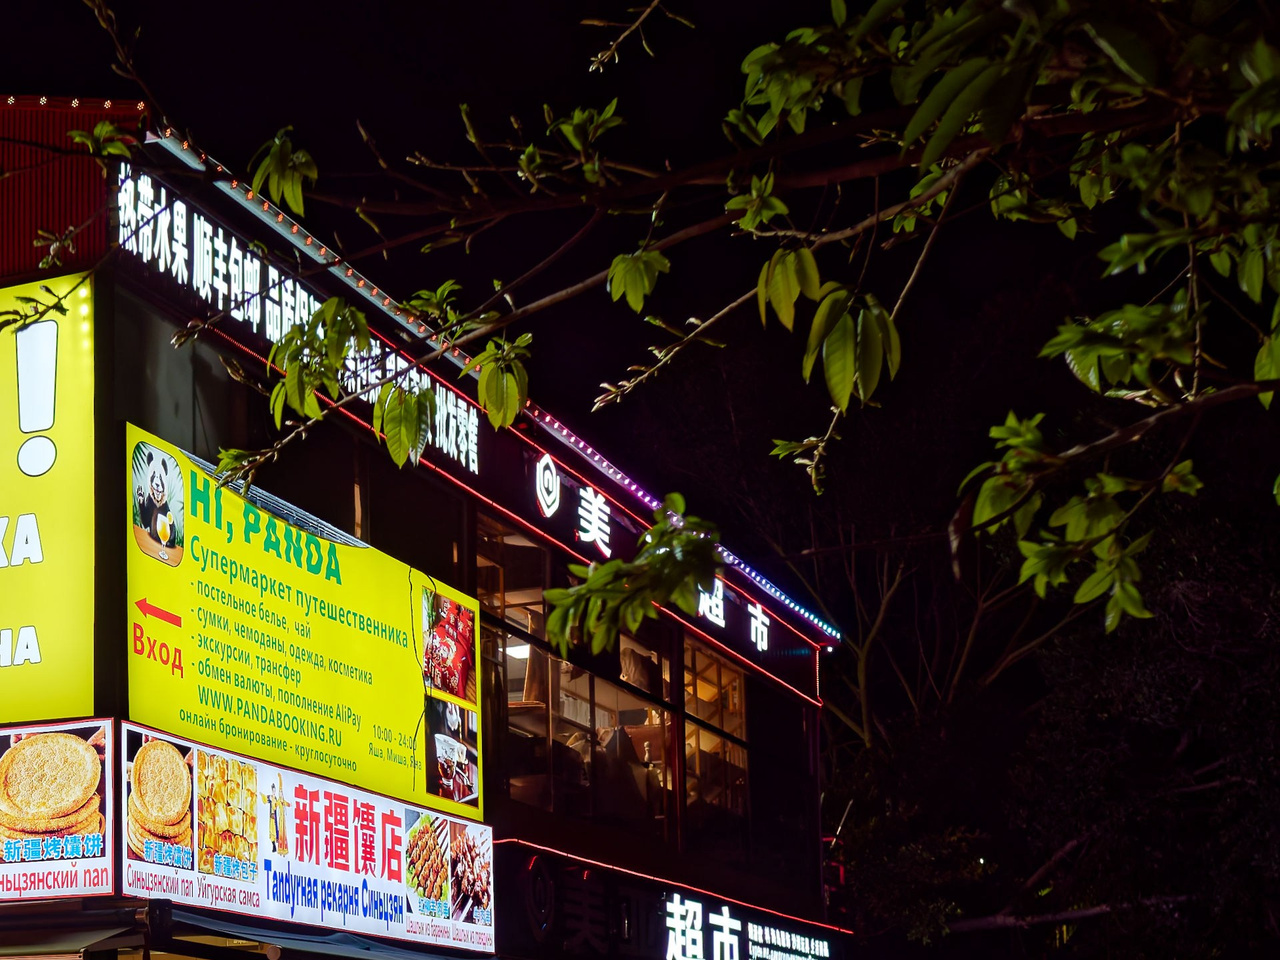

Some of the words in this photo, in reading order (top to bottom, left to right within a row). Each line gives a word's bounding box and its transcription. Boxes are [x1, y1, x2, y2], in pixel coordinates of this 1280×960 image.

[193, 211, 261, 334] 顺丰包邮
[190, 470, 234, 543] HI,
[243, 502, 342, 585] PANDA
[190, 535, 292, 602] Супермаркет
[296, 590, 409, 649] путешественника
[197, 580, 257, 618] постельное
[258, 603, 290, 633] белье,
[294, 619, 312, 641] чай
[133, 622, 184, 678] Вход
[197, 605, 231, 636] сумки,
[234, 622, 287, 656] чемоданы,
[289, 642, 326, 672] одежда,
[328, 657, 373, 686] косметика
[197, 636, 254, 673] экскурсии,
[255, 653, 302, 687] трансфер
[197, 662, 232, 687] обмен
[233, 673, 276, 702] валюты,
[277, 688, 335, 720] пополнение
[335, 706, 363, 732] AliPay
[198, 685, 343, 747] WWW.PANDABOOKING.RU
[179, 707, 217, 733] онлайн
[218, 717, 288, 753] бронирование
[294, 743, 358, 772] круглосуточно
[368, 742, 385, 761] Яша,
[386, 748, 408, 769] Миша,
[372, 724, 393, 744] 10:00
[3, 833, 103, 862] 新疆烤馕饼
[294, 784, 402, 883] 新疆馕店
[127, 863, 178, 897] Синьцзянский
[197, 875, 236, 906] Уйгурская
[238, 889, 260, 908] самса
[362, 879, 403, 930] Синьцзян
